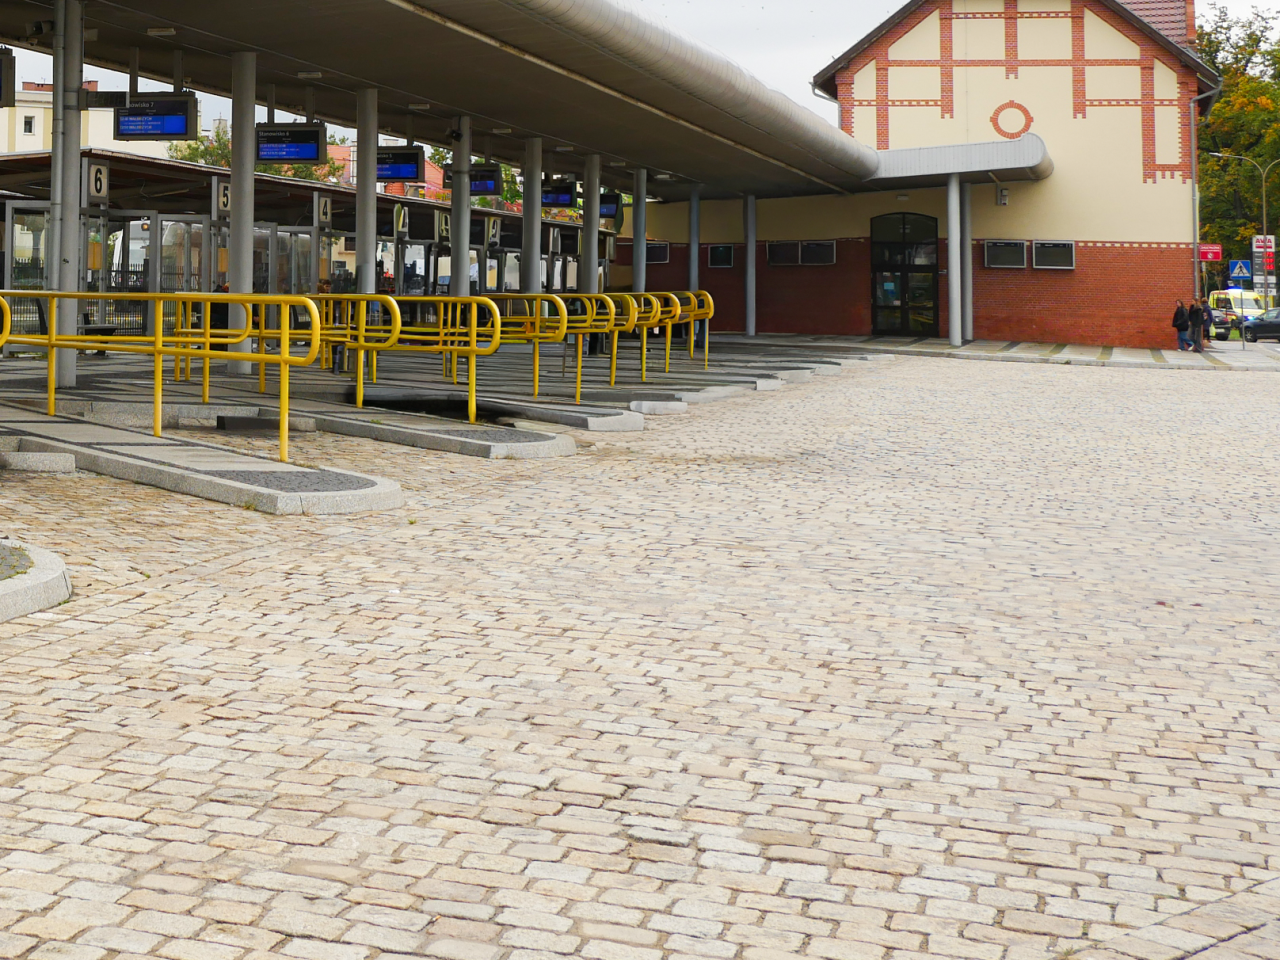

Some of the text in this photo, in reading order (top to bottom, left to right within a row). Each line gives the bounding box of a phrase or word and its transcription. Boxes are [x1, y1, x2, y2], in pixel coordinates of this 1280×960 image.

[95, 168, 103, 194] 6
[222, 185, 229, 208] 5
[322, 199, 329, 220] 4
